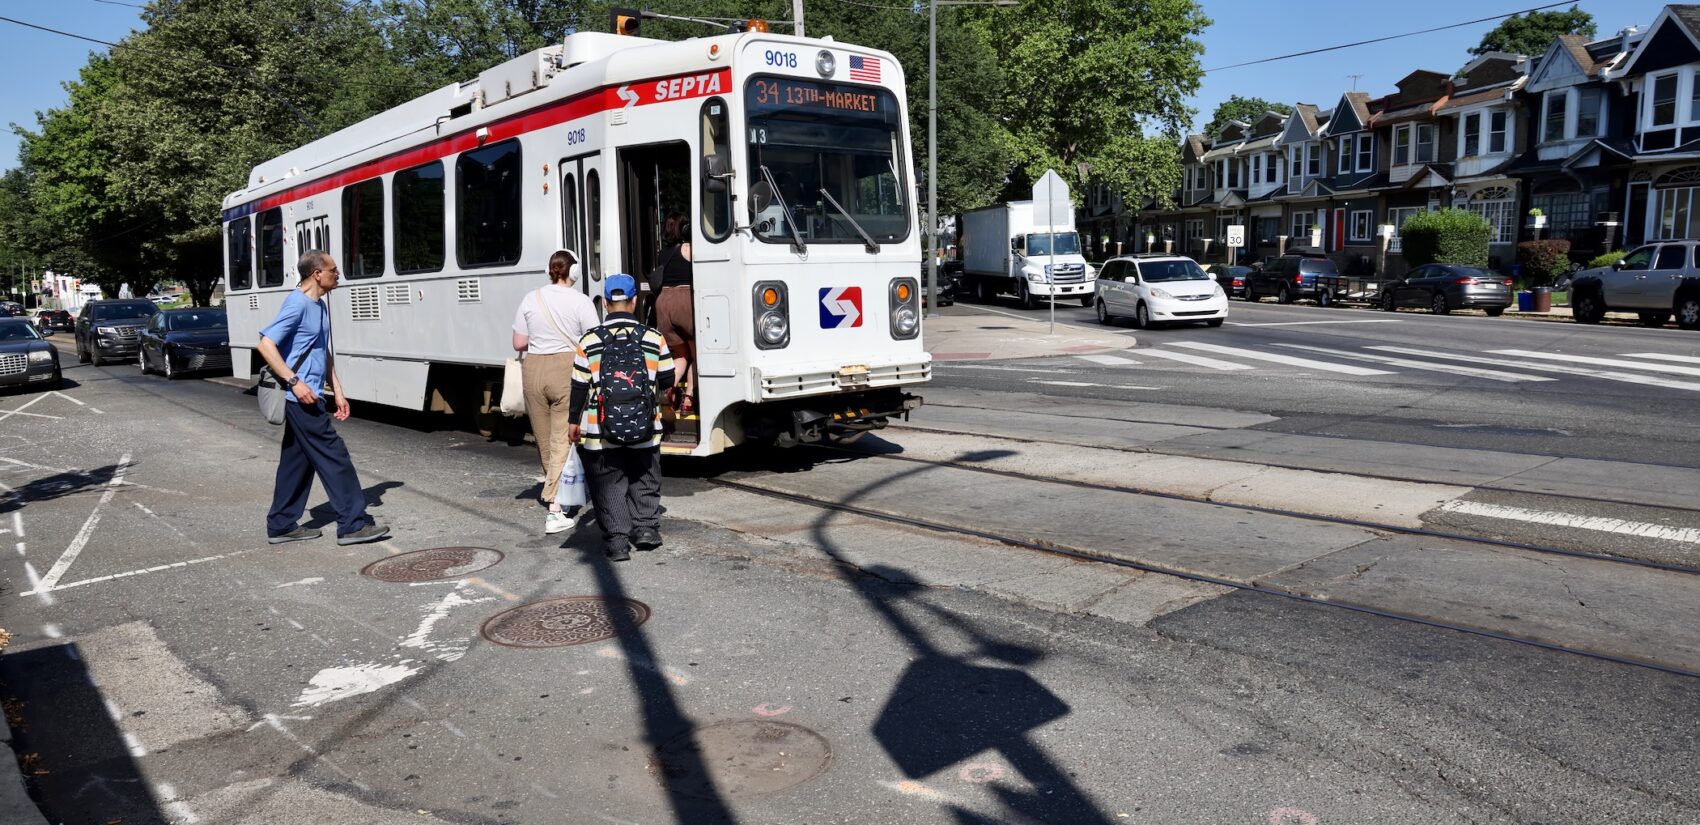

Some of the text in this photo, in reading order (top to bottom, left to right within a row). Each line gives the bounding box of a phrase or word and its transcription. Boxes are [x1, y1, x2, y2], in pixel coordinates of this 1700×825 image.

[765, 50, 797, 68] 9018
[655, 73, 720, 100] SEPTA
[756, 80, 876, 112] 34 13TH-MARKET
[568, 128, 585, 145] 9018
[760, 129, 766, 143] 3
[1229, 236, 1242, 244] 30
